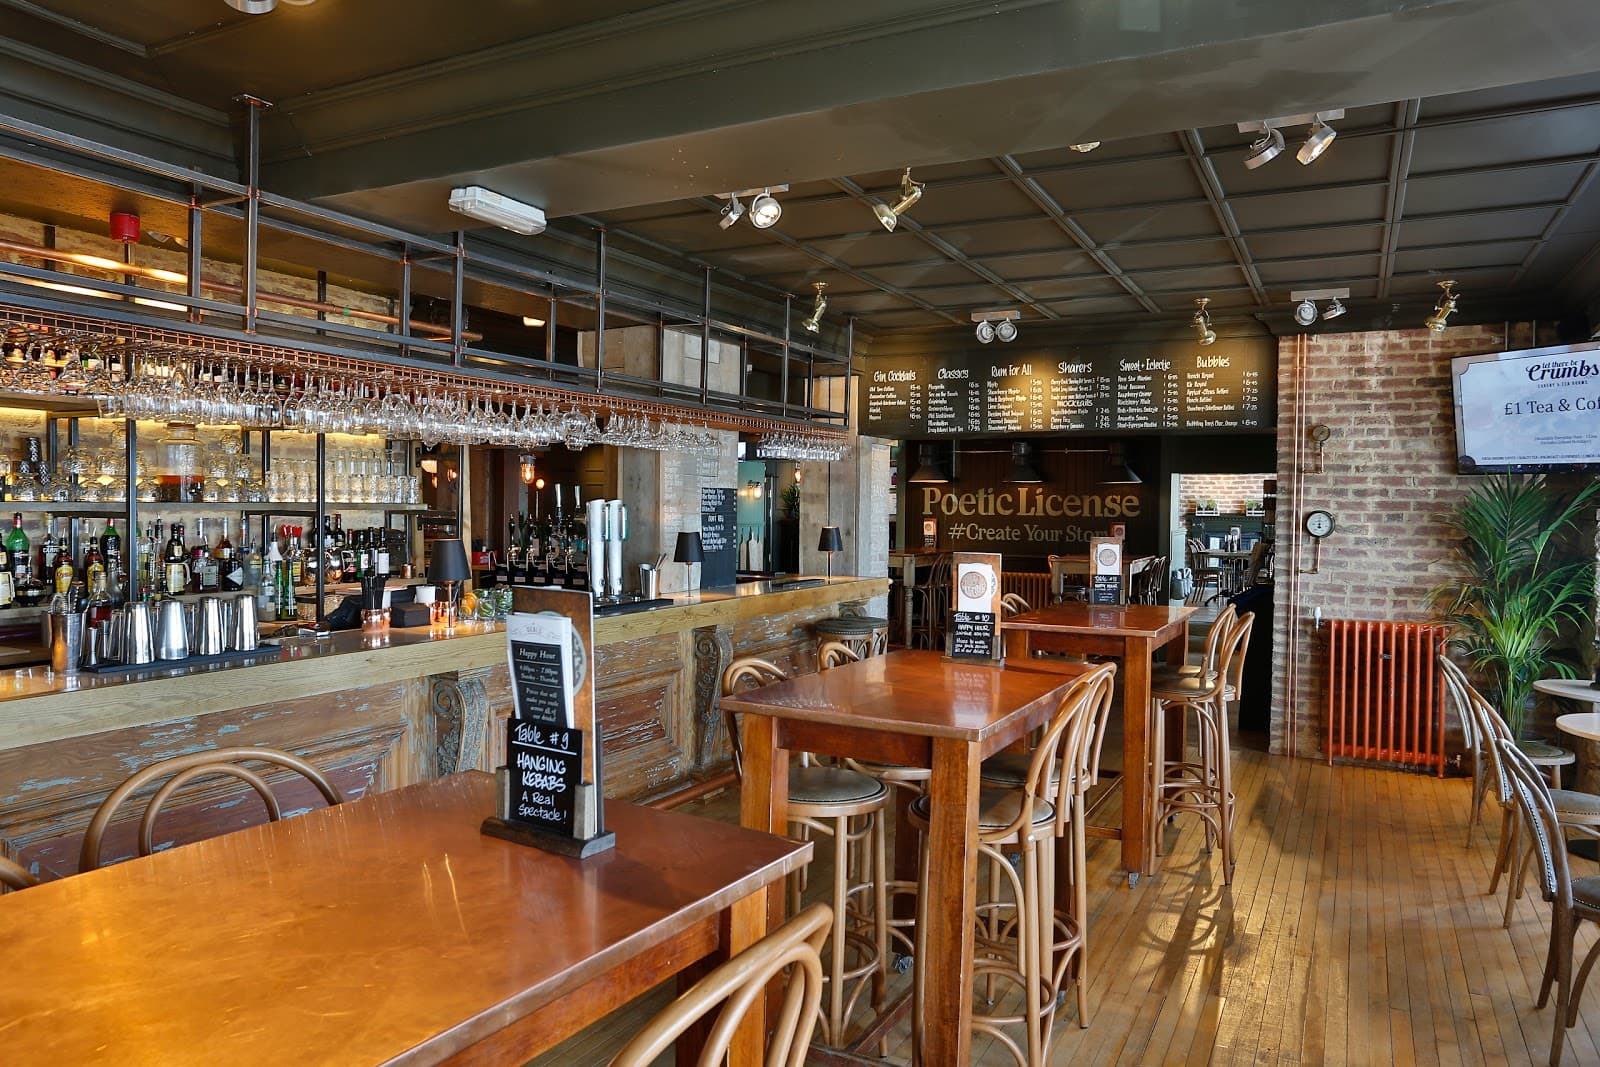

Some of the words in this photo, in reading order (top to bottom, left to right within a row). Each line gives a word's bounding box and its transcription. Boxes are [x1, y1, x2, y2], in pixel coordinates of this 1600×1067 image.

[1058, 361, 1092, 374] Sharers
[1120, 358, 1141, 372] Sweet
[1146, 358, 1171, 371] Eclectic
[1196, 355, 1230, 368] Bubbles
[874, 371, 886, 382] Gin
[888, 370, 916, 382] Cocktails
[938, 368, 969, 380] Classics
[992, 366, 1008, 377] Rum
[1008, 364, 1020, 376] For
[1021, 364, 1032, 376] All
[1525, 360, 1599, 381] Crumbs
[1504, 402, 1522, 416] £1
[1527, 400, 1553, 414] Tea
[1558, 398, 1570, 411] &
[922, 488, 1013, 516] Poetic
[1017, 488, 1140, 518] License
[948, 522, 1021, 541] #Create
[1024, 524, 1062, 542] Your
[520, 648, 538, 659] Happy
[539, 650, 556, 659] Hour
[515, 723, 544, 744] Table
[550, 732, 559, 745] #
[560, 732, 569, 750] 9
[517, 752, 566, 774] HANGING
[522, 771, 566, 793] KEBABS
[522, 791, 528, 802] A
[532, 792, 554, 807] Real
